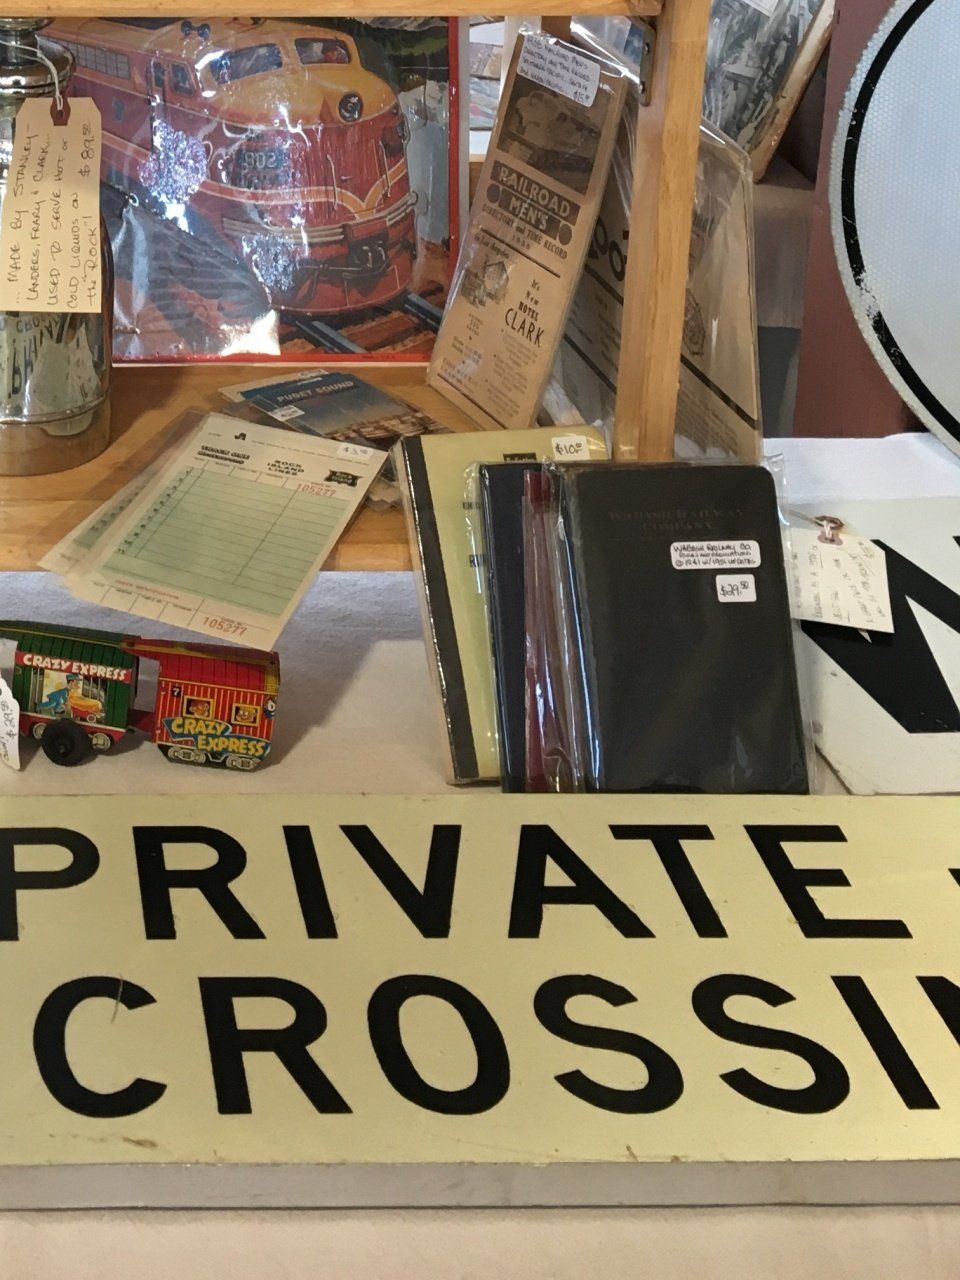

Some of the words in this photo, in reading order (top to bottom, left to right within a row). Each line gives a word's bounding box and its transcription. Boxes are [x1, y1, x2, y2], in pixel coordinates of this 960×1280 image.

[498, 165, 571, 218] RAILROAD
[50, 190, 62, 230] SERVE
[509, 196, 550, 231] MEN'S
[543, 237, 569, 260] RECORD
[7, 240, 21, 283] MADE
[46, 263, 60, 306] USED
[66, 276, 78, 310] COLD
[517, 300, 539, 322] HOTEL
[504, 308, 545, 348] CLARK
[275, 389, 314, 403] PUGET
[316, 380, 355, 395] SOUND
[266, 462, 305, 474] ISLAND
[267, 466, 299, 477] LINES
[273, 459, 303, 469] ROCK
[297, 482, 337, 497] 105277
[673, 543, 705, 552] WABASH
[203, 616, 248, 636] 105277
[22, 654, 71, 670] CRAZY
[71, 661, 128, 681] EXPRESS
[173, 687, 180, 697] 7
[171, 717, 228, 736] CRAZY
[197, 734, 268, 757] EXPRESS
